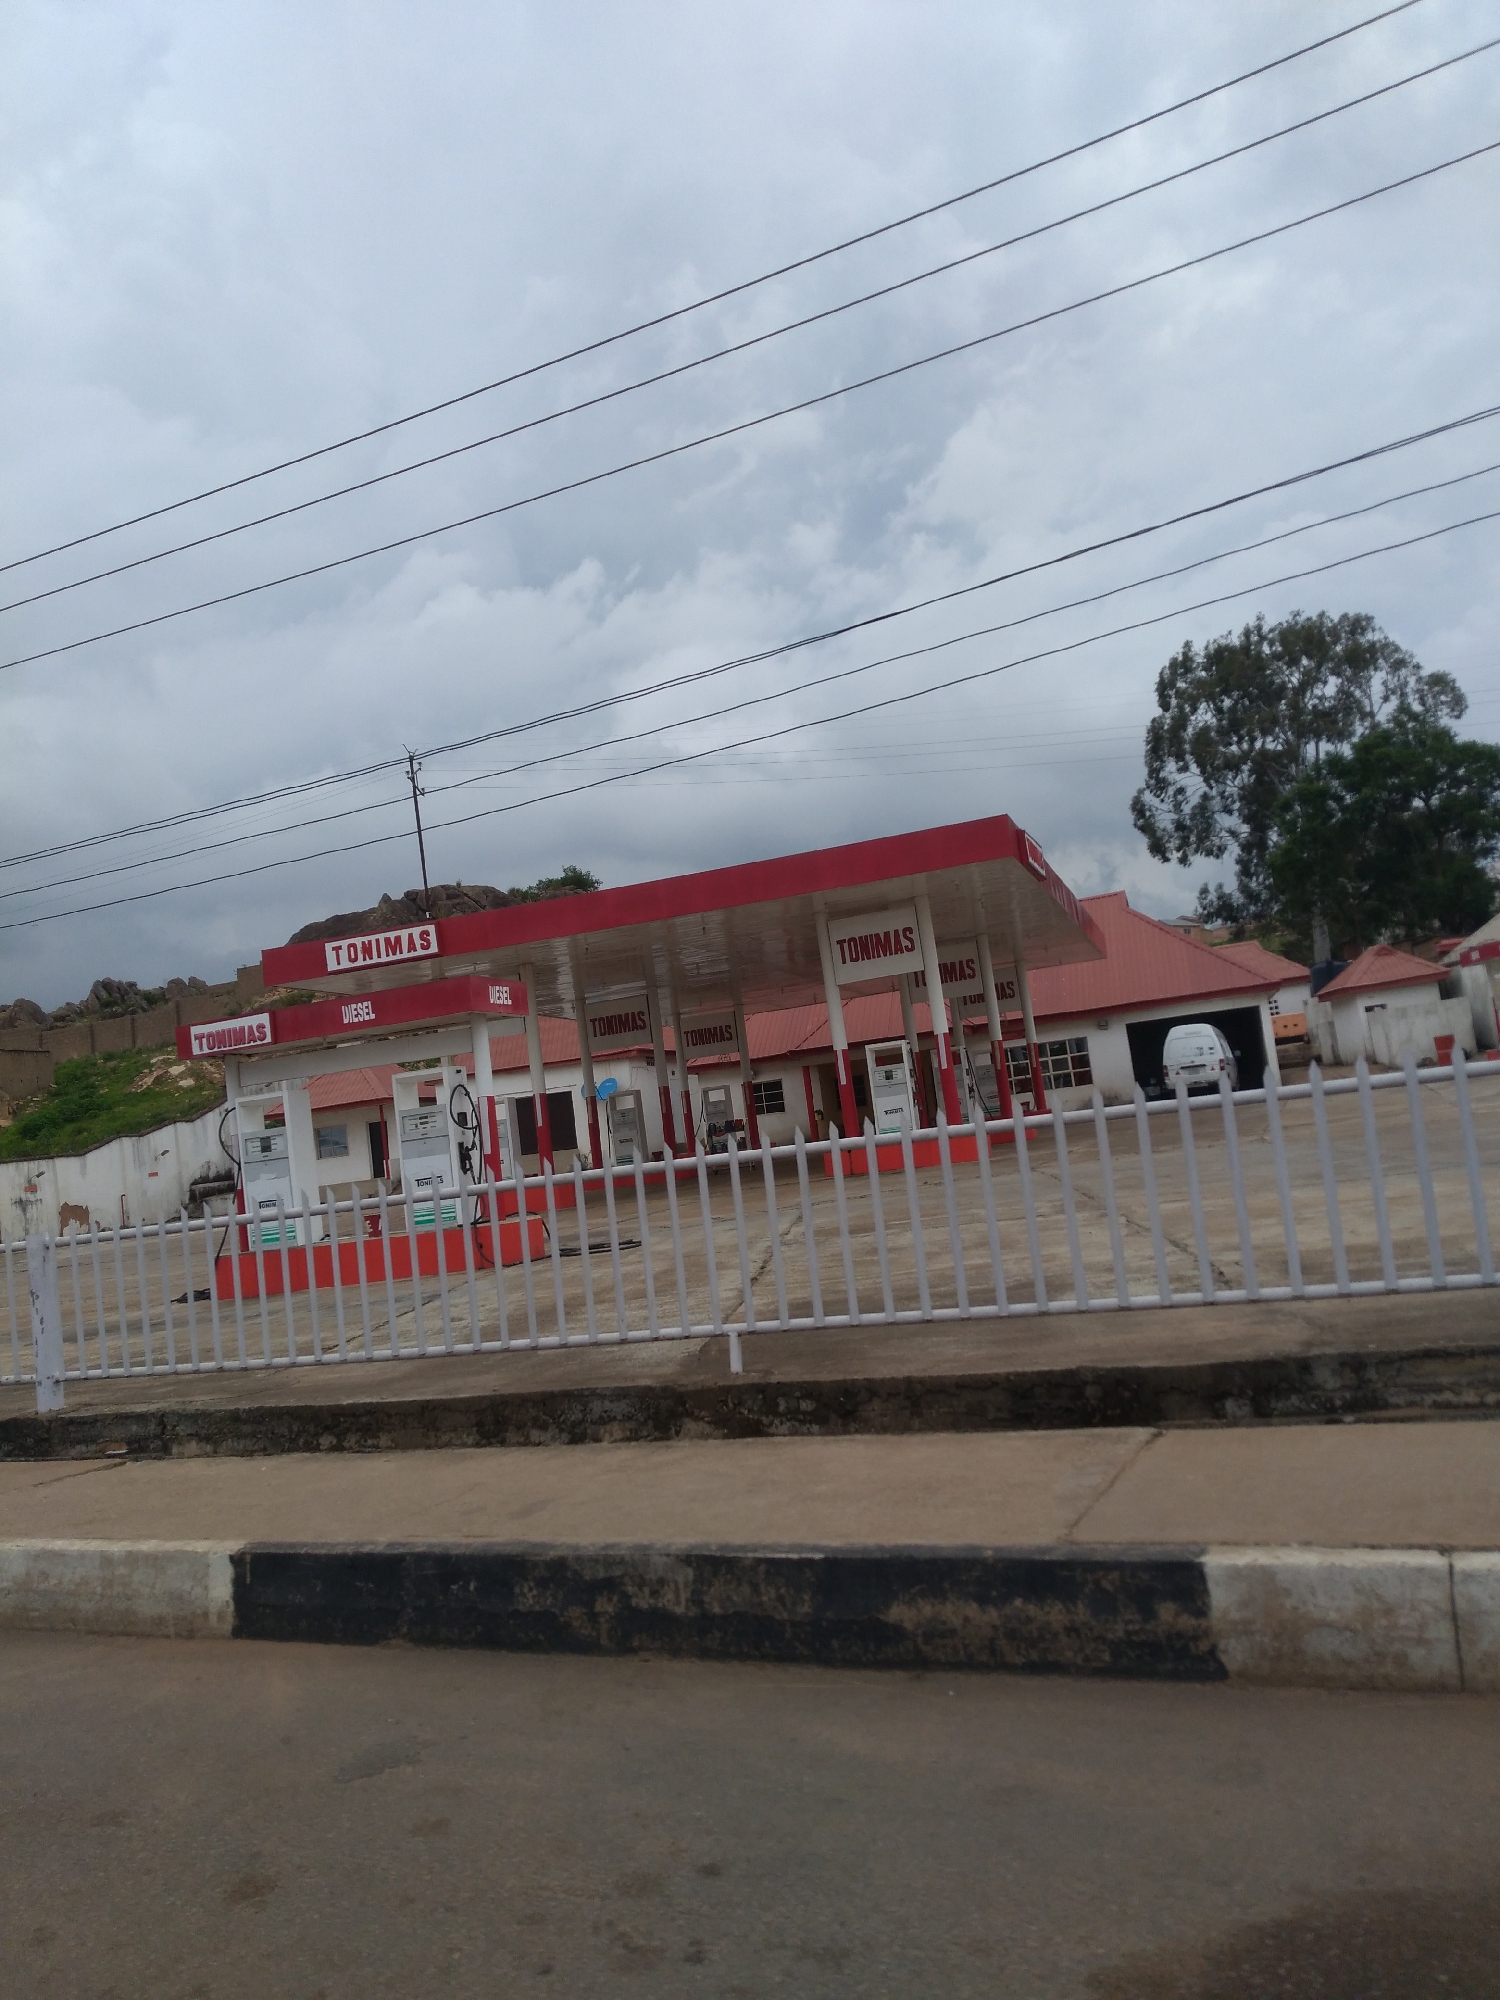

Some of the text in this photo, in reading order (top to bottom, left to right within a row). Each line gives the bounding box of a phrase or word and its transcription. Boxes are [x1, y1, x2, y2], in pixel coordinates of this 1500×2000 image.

[332, 929, 431, 966] TONIMAS
[836, 926, 916, 965] TONIMAS
[488, 984, 513, 1005] DIESEL
[341, 1001, 376, 1024] DIESEL
[589, 1010, 647, 1038] TONIMAS
[194, 1022, 267, 1052] TONIMAS
[683, 1024, 733, 1048] TONIMAS
